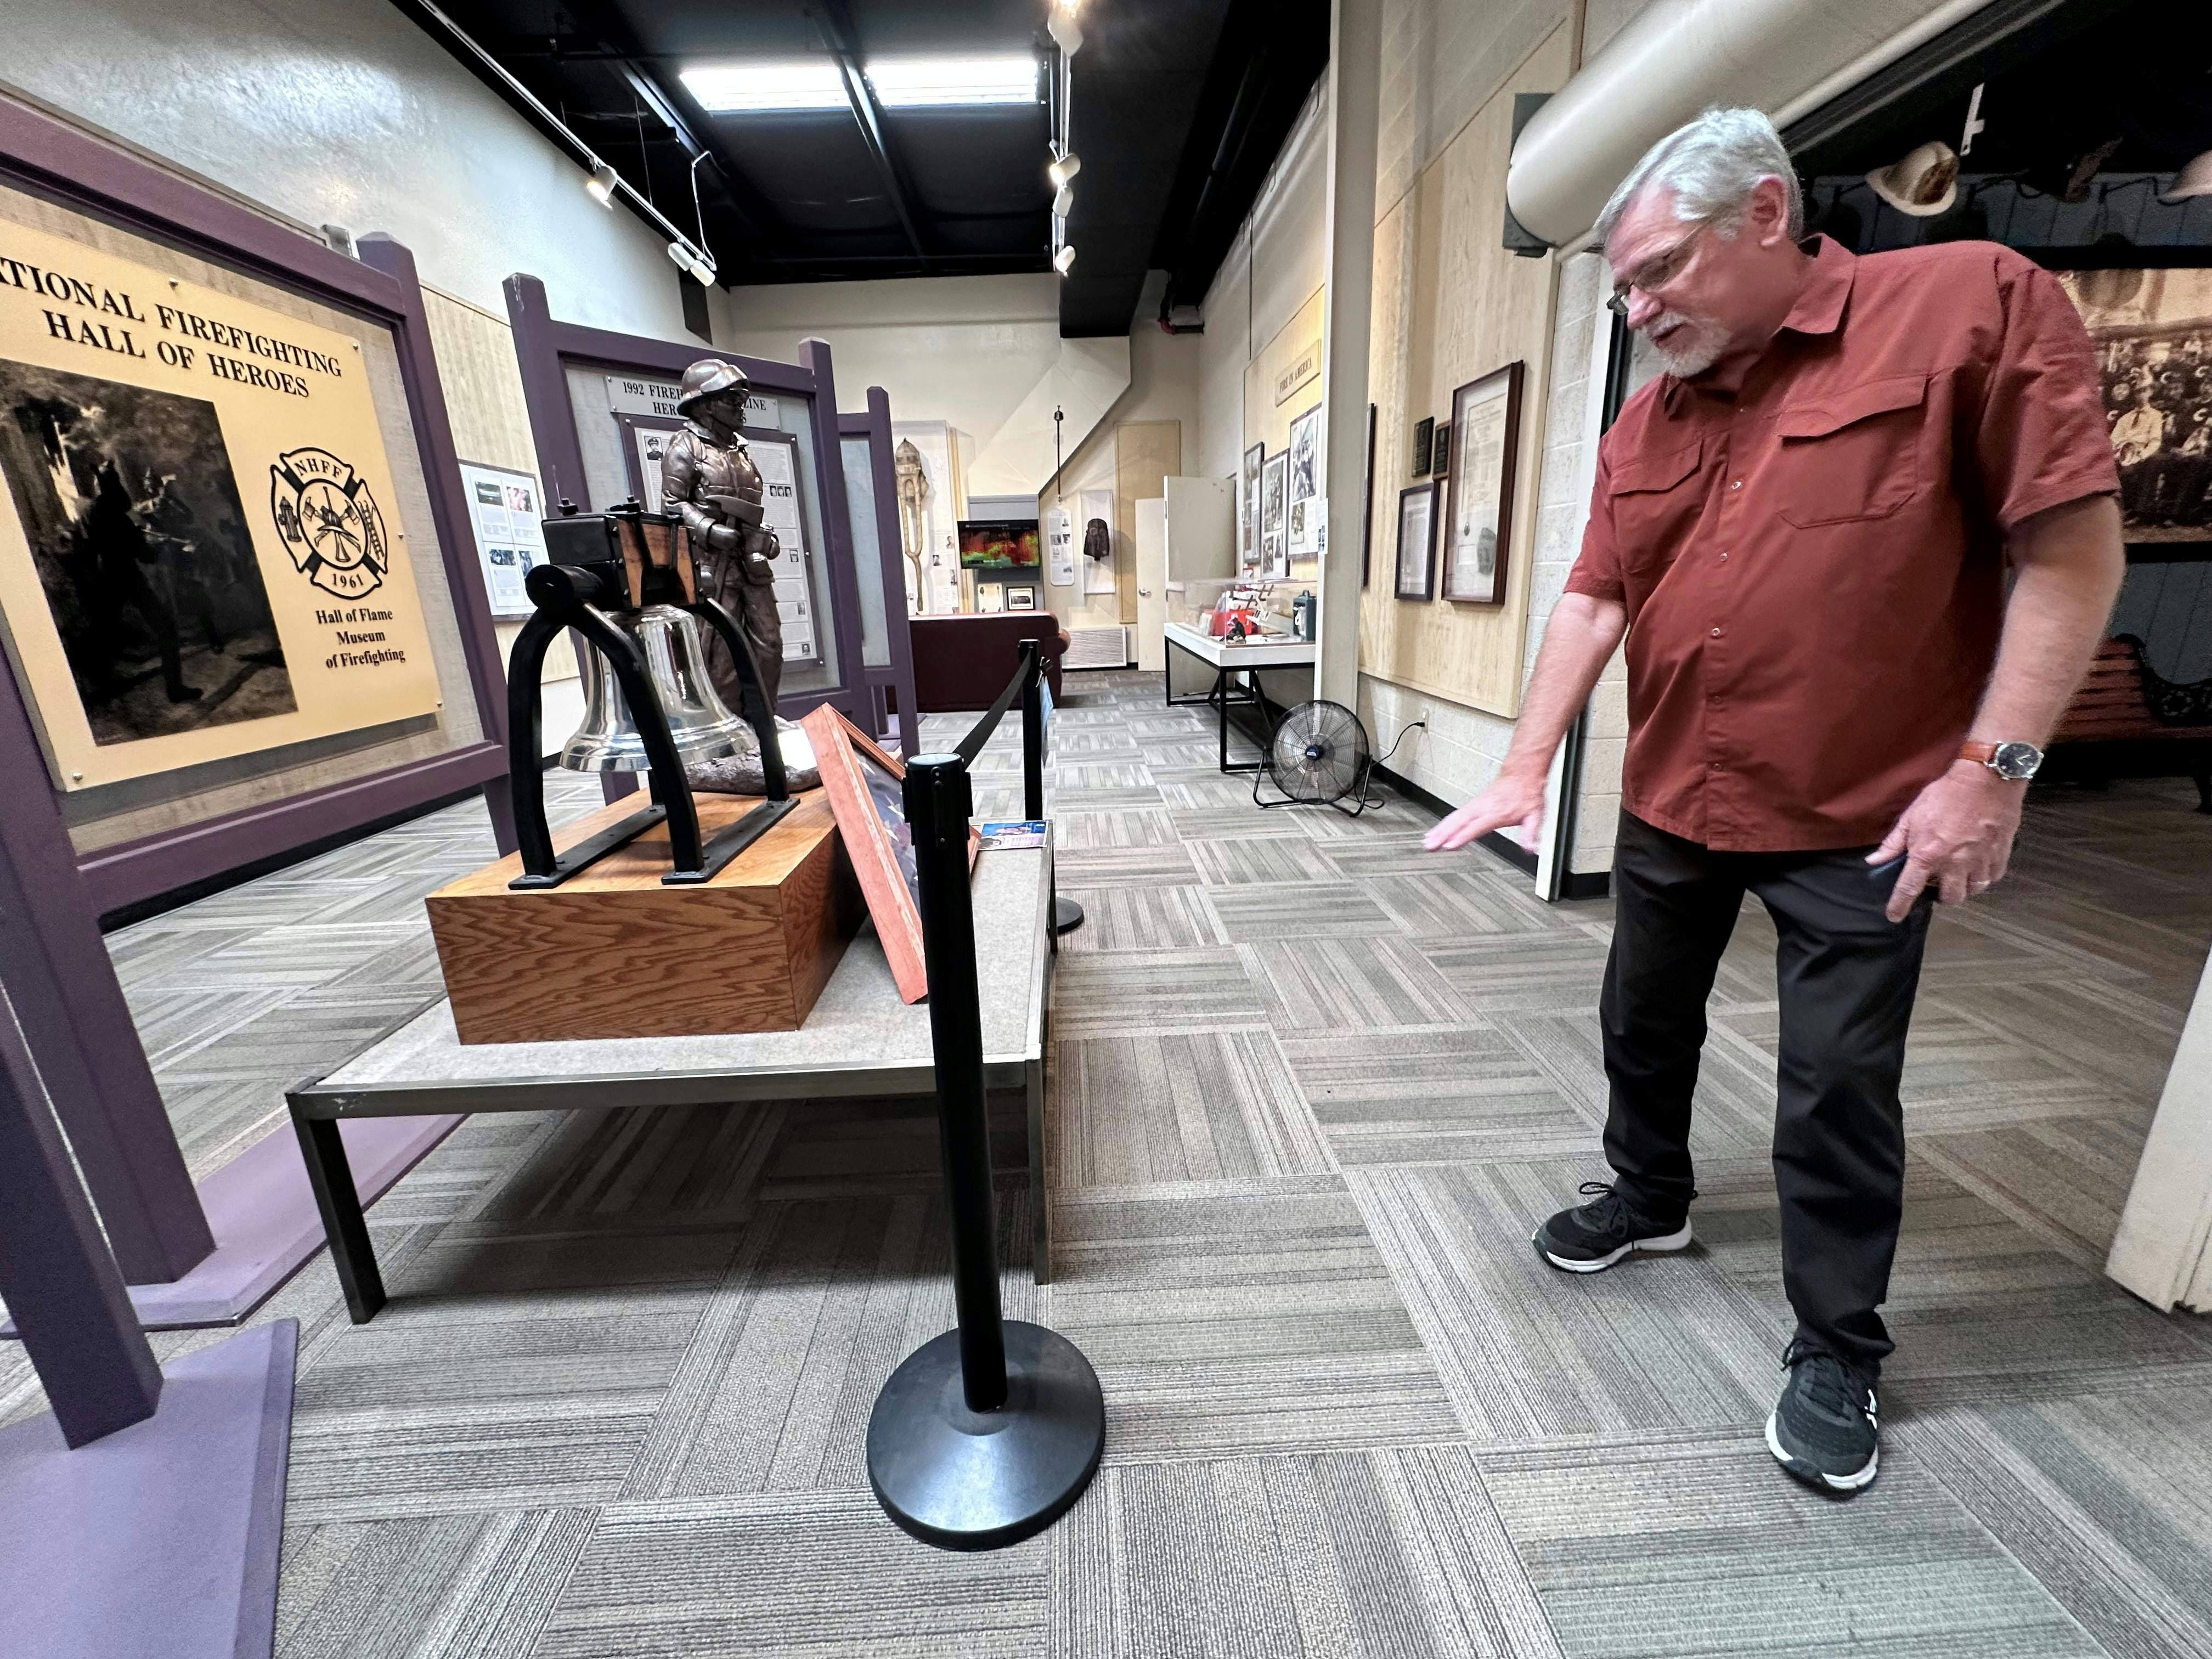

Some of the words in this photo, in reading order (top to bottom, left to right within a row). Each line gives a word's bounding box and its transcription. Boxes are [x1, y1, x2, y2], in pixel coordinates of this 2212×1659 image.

[155, 303, 342, 377] FIREFIGHTING
[42, 309, 146, 359] HALL
[157, 341, 194, 369] OF
[206, 353, 309, 398] HEROES
[623, 382, 644, 395] 1992
[648, 385, 683, 400] FIREH
[653, 402, 678, 416] HER
[294, 458, 343, 478] NHFF
[332, 573, 364, 588] 1961
[316, 610, 343, 624] Hall
[346, 608, 358, 623] of
[359, 608, 393, 622] Flame
[337, 630, 386, 645] Museum
[325, 653, 338, 669] of
[340, 648, 406, 669] Firefighting
